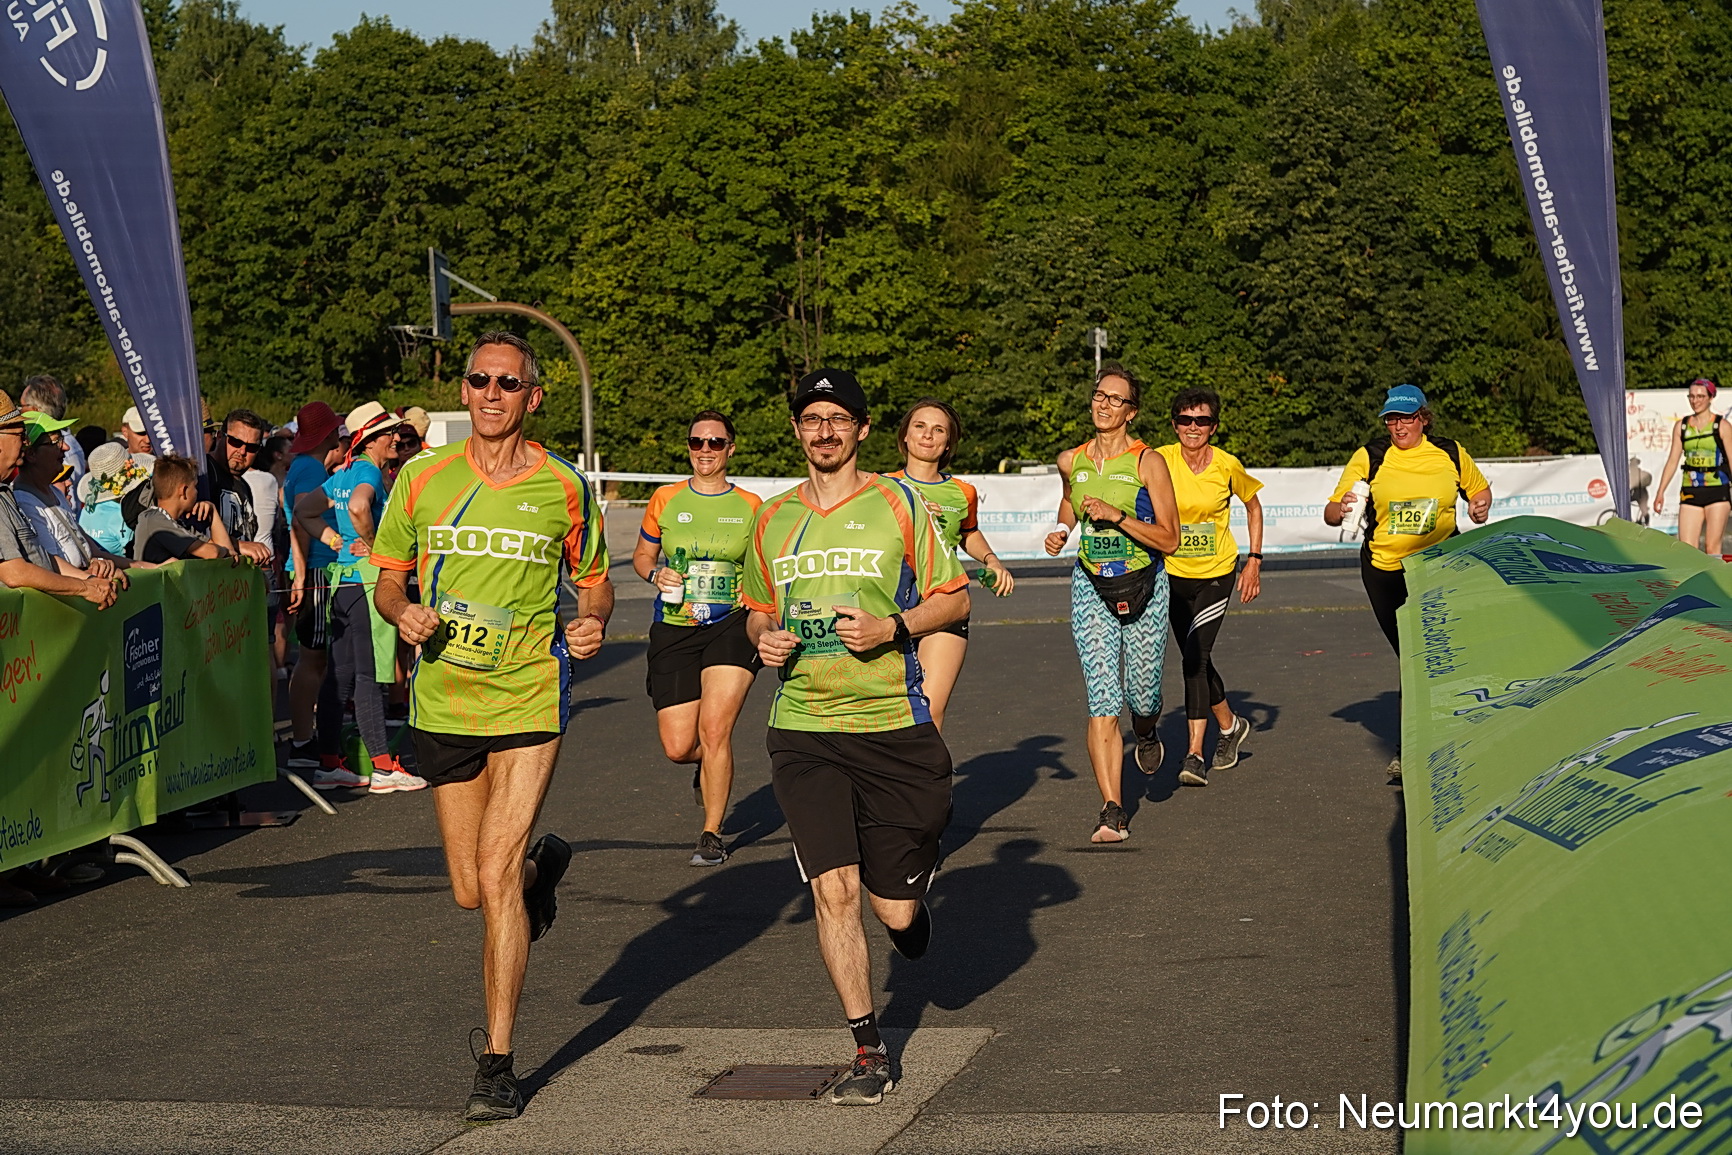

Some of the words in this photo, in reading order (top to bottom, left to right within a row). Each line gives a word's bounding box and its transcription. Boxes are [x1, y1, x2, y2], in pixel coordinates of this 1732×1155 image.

[1521, 490, 1591, 507] FAHRRÄDER
[428, 526, 554, 564] BOCK
[1093, 536, 1121, 549] 594
[773, 548, 885, 586] BOCK
[697, 575, 726, 590] 613
[444, 619, 489, 648] 612
[800, 616, 838, 640] 634
[129, 636, 160, 663] Fischer
[817, 639, 844, 649] Stepha
